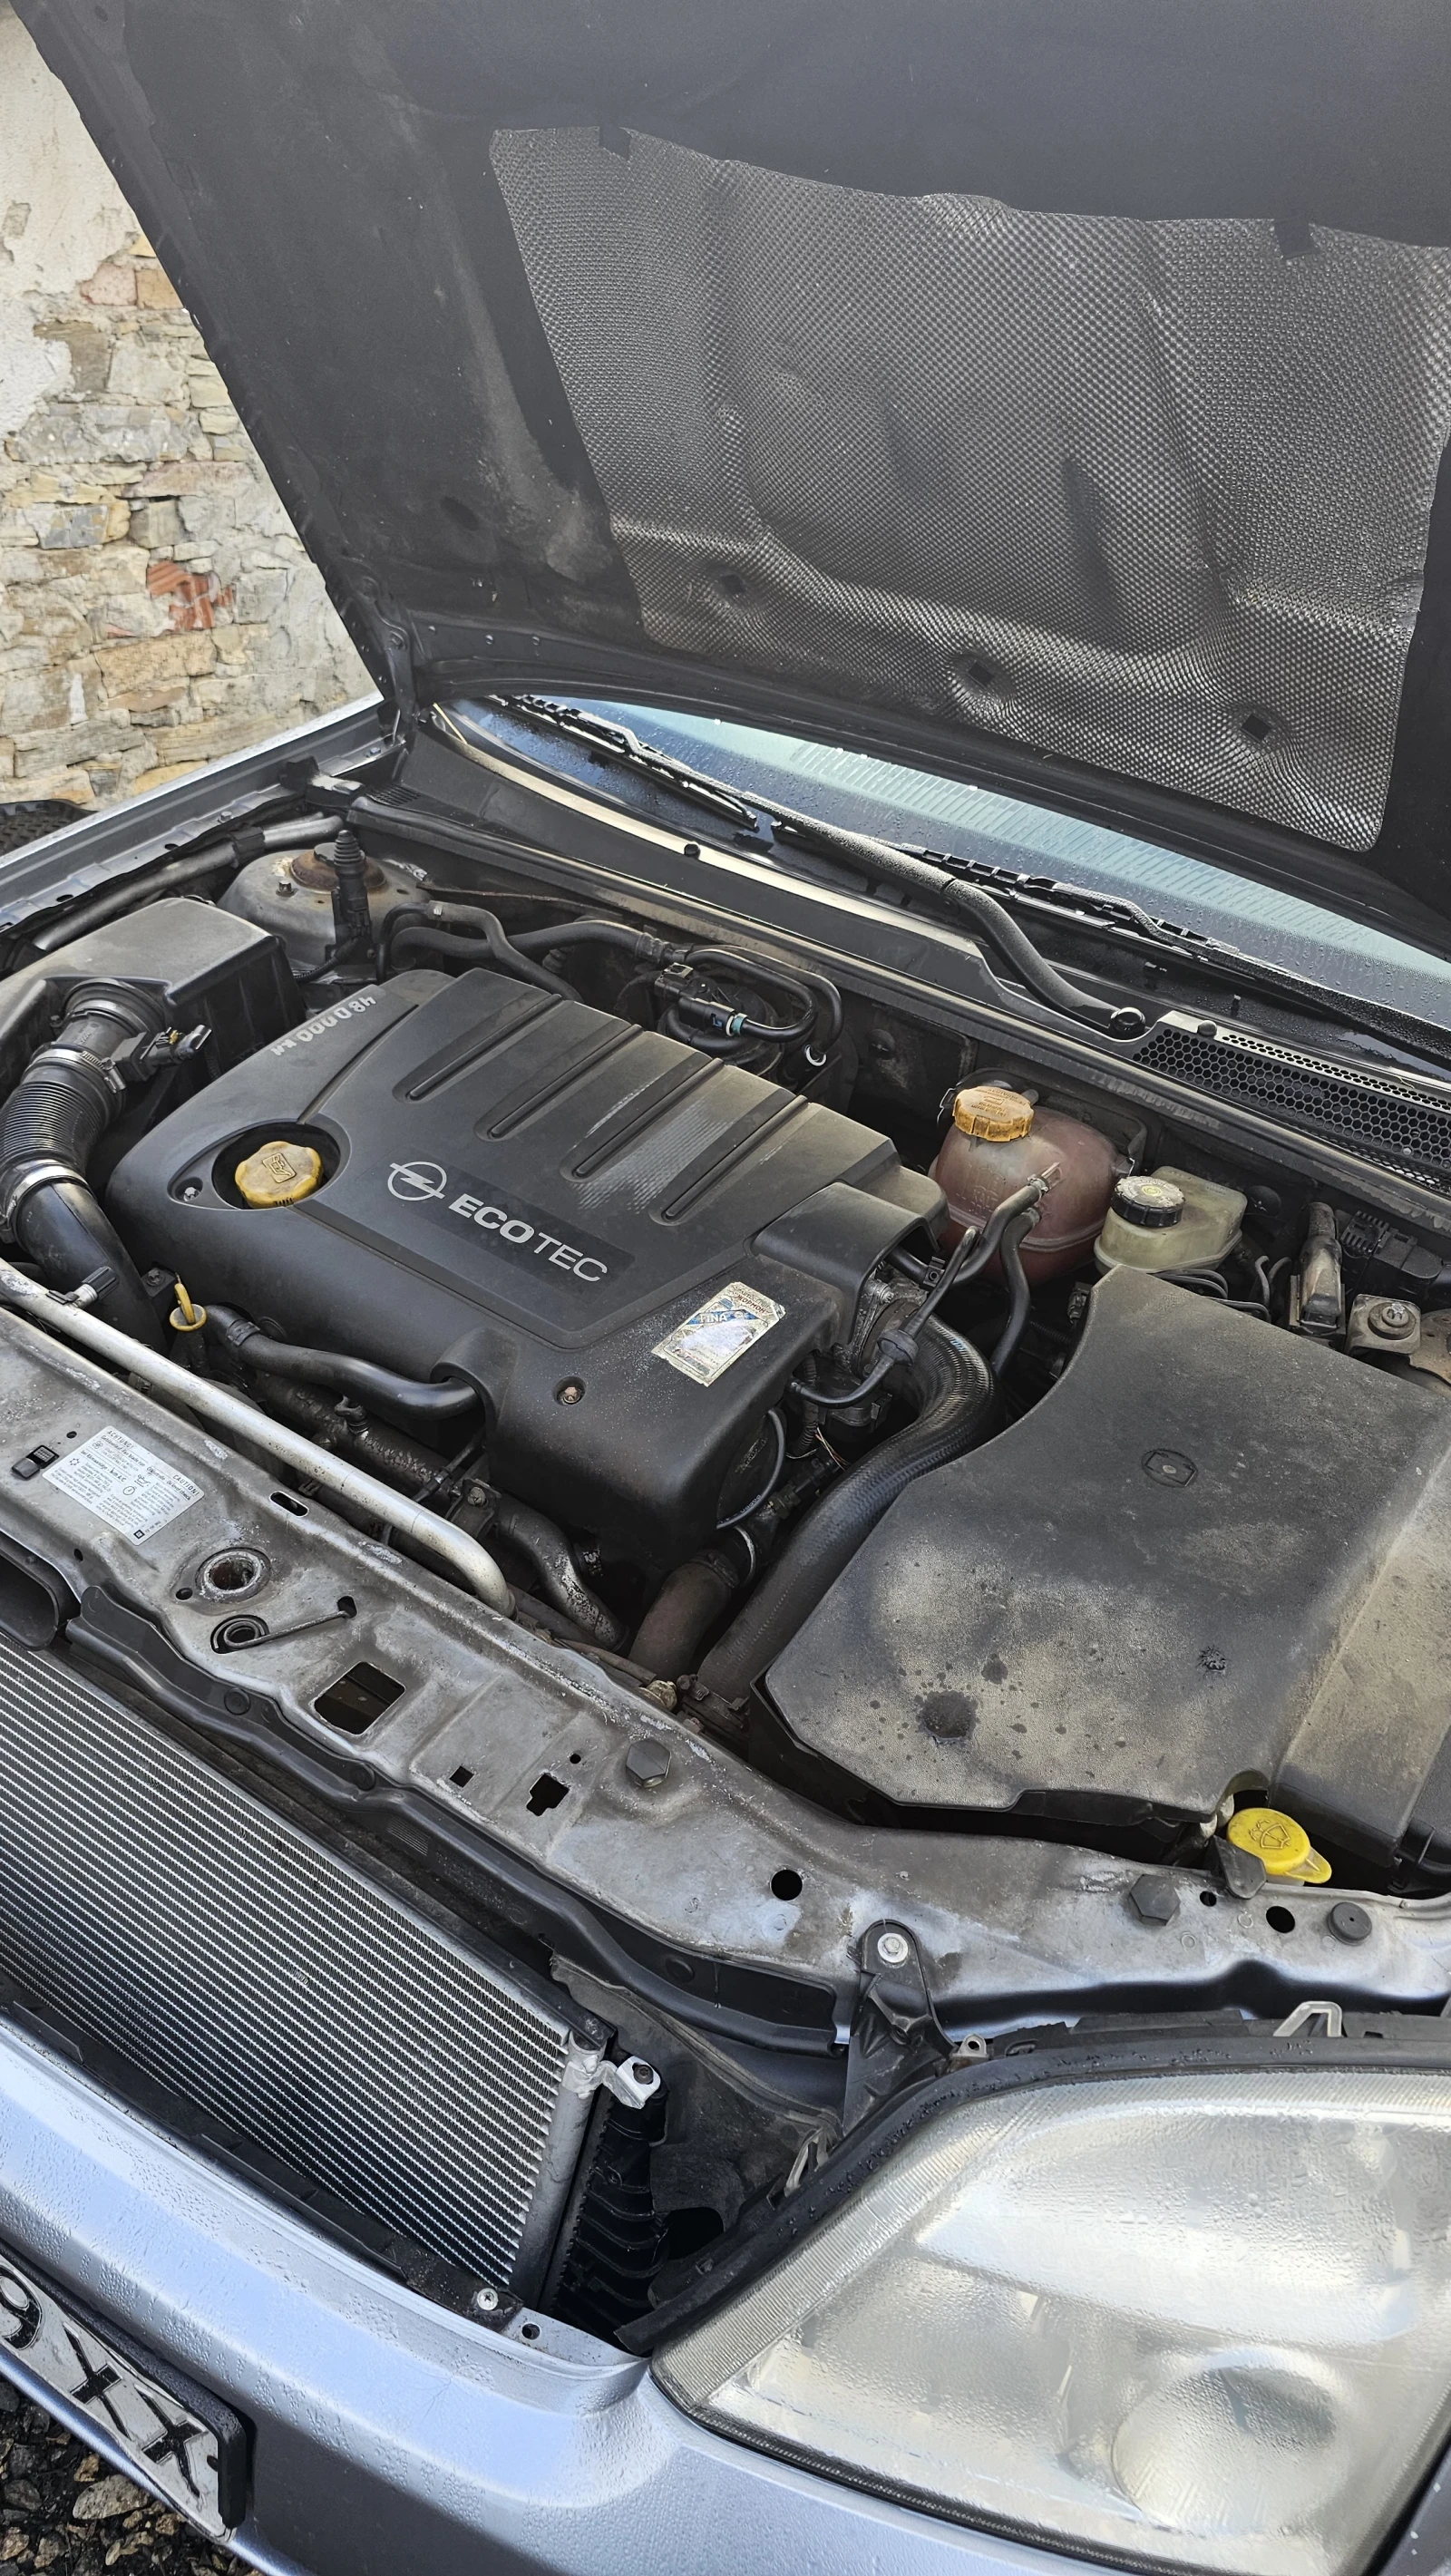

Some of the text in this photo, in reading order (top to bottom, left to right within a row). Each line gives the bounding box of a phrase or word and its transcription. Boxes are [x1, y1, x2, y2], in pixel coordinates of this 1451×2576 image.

[448, 1192, 608, 1282] ECOTEC
[699, 1312, 728, 1324] FINA
[170, 1473, 201, 1496] CAUTION!
